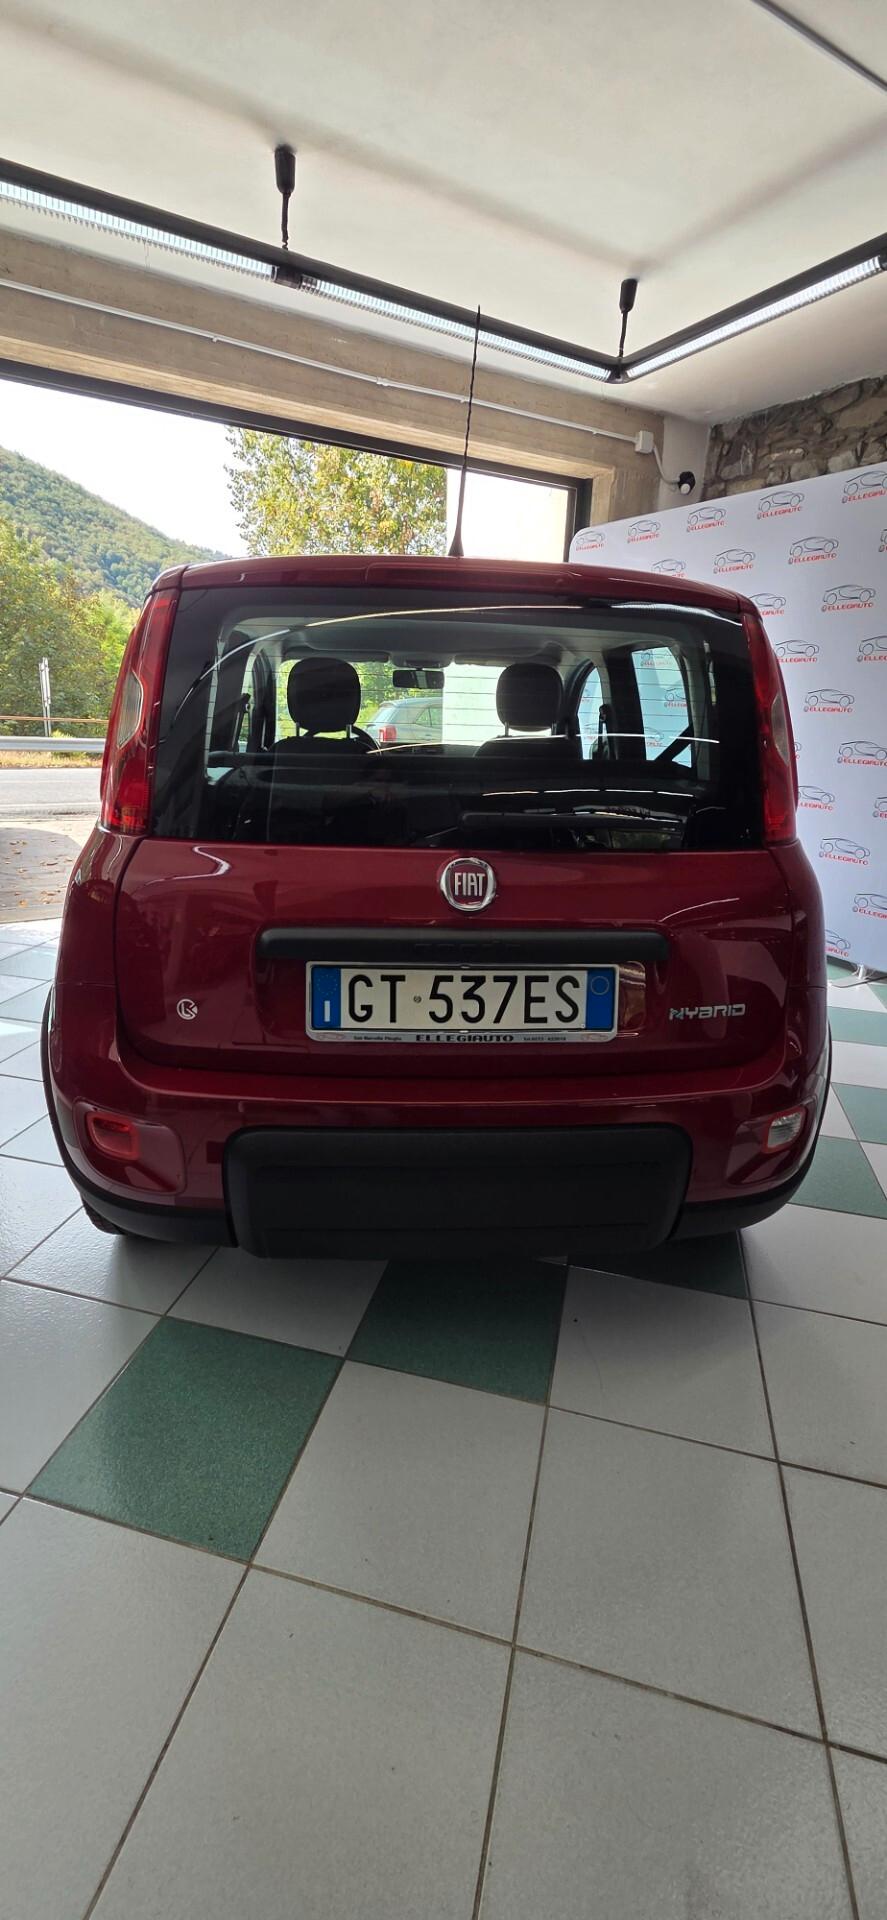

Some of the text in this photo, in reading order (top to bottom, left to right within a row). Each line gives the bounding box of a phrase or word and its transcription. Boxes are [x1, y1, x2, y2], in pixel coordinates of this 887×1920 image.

[848, 489, 887, 502] ELLEGIAU
[793, 552, 837, 564] ELLEGIAUTO
[827, 602, 874, 612] ELLEGIAUTO
[800, 802, 833, 811] LEGIAUTO
[824, 853, 869, 866] ELLEGIAUTO
[454, 872, 486, 897] FIAT
[348, 974, 406, 1023] GT
[428, 975, 580, 1024] 537ES
[415, 1034, 514, 1042] ELLEGIAUTO
